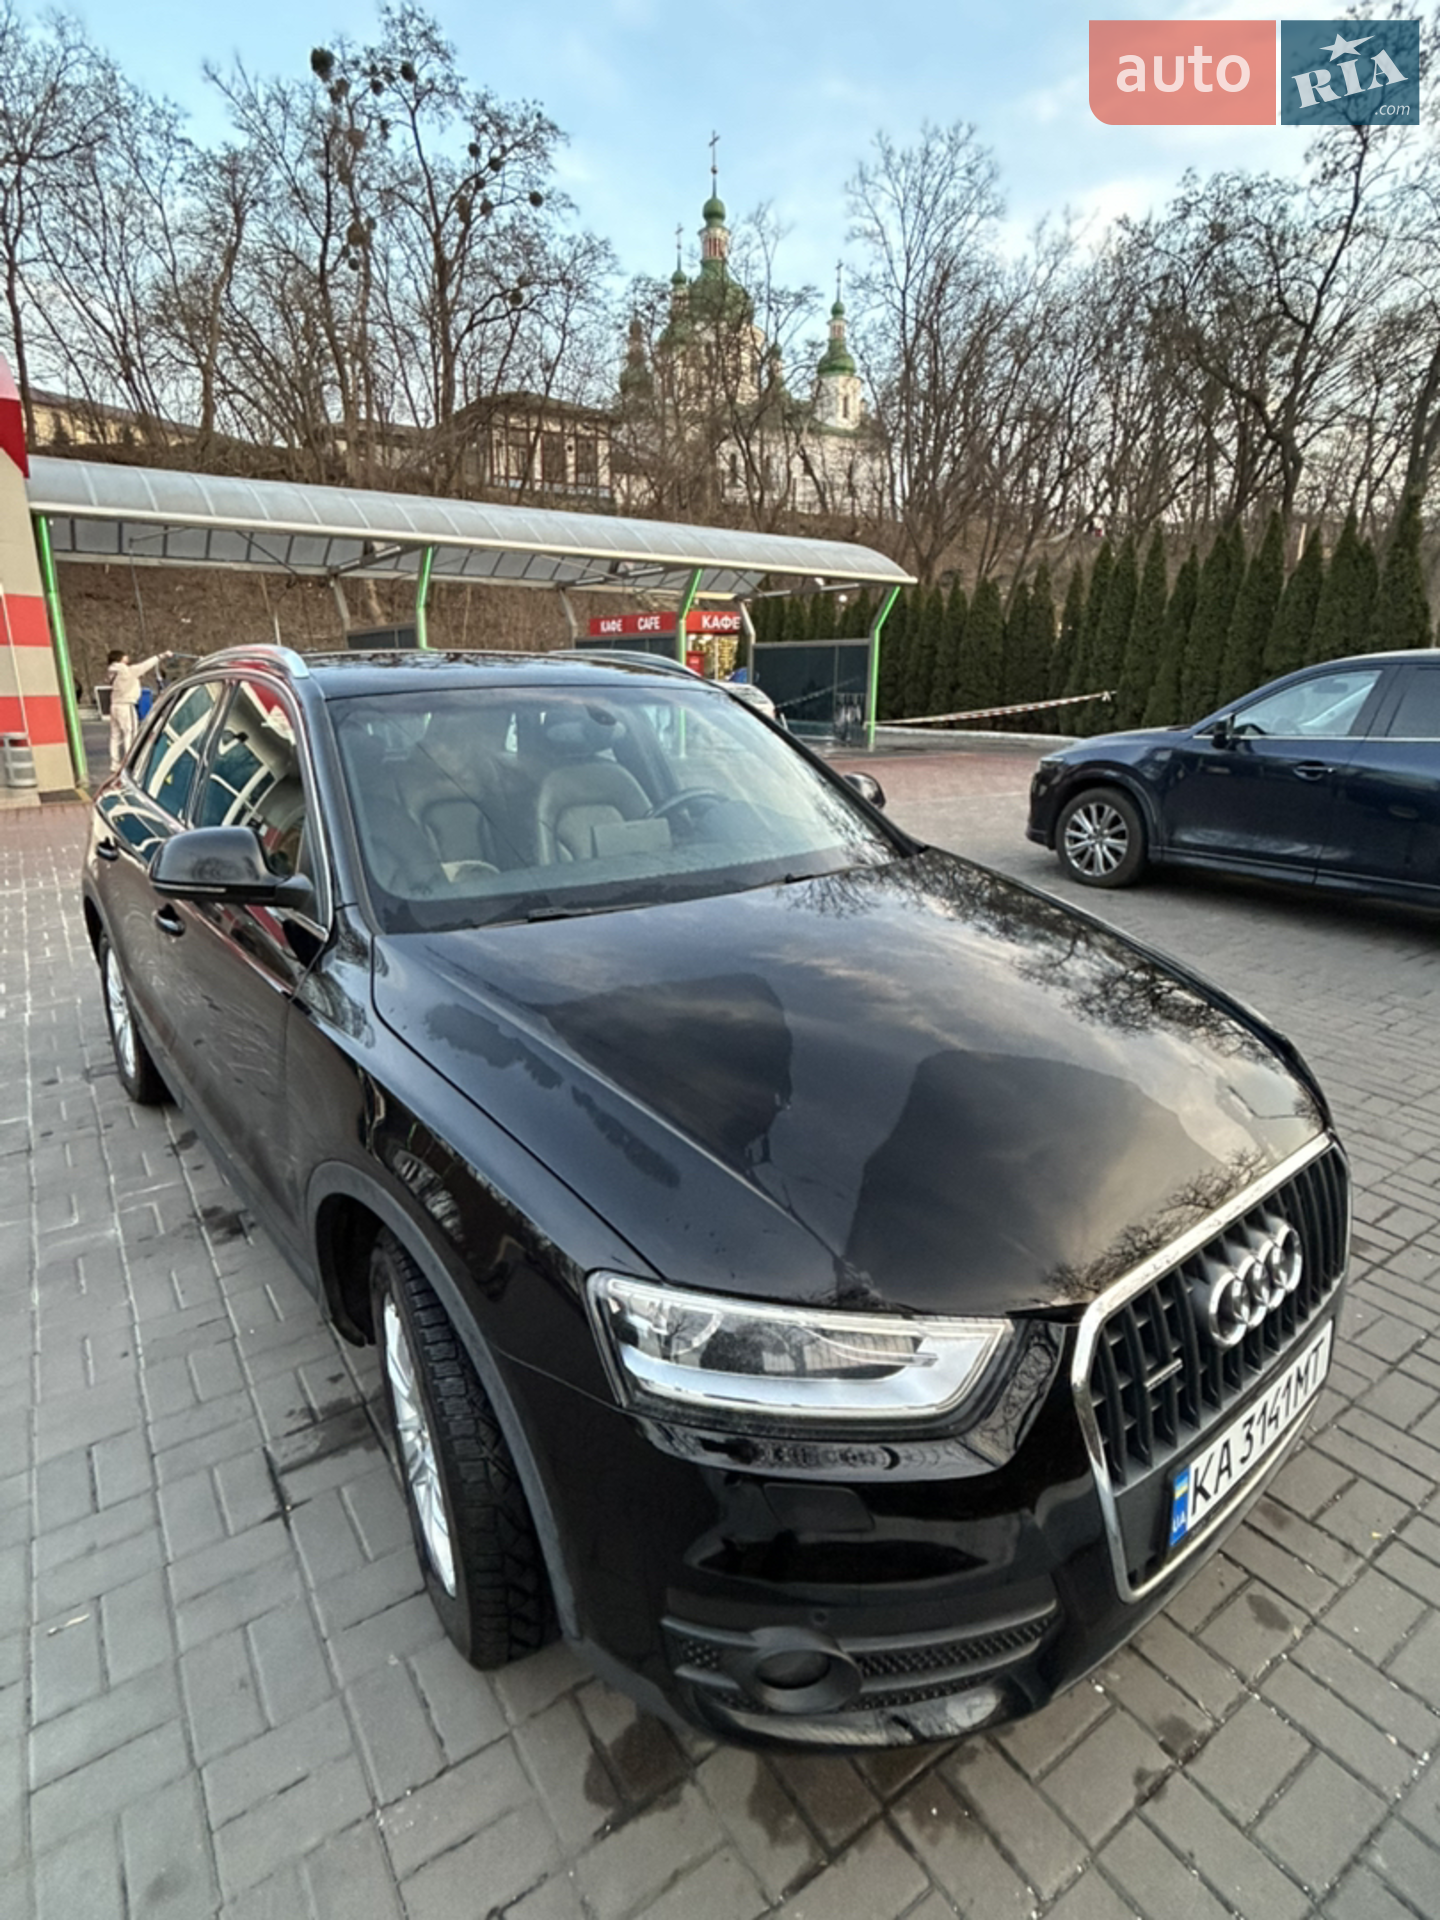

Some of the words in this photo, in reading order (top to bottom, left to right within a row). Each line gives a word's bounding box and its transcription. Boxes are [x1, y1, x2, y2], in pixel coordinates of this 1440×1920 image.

[600, 619, 622, 632] КАФЕ
[637, 616, 661, 630] CAFE
[701, 615, 741, 630] КАФЕ
[1172, 1511, 1187, 1533] UA
